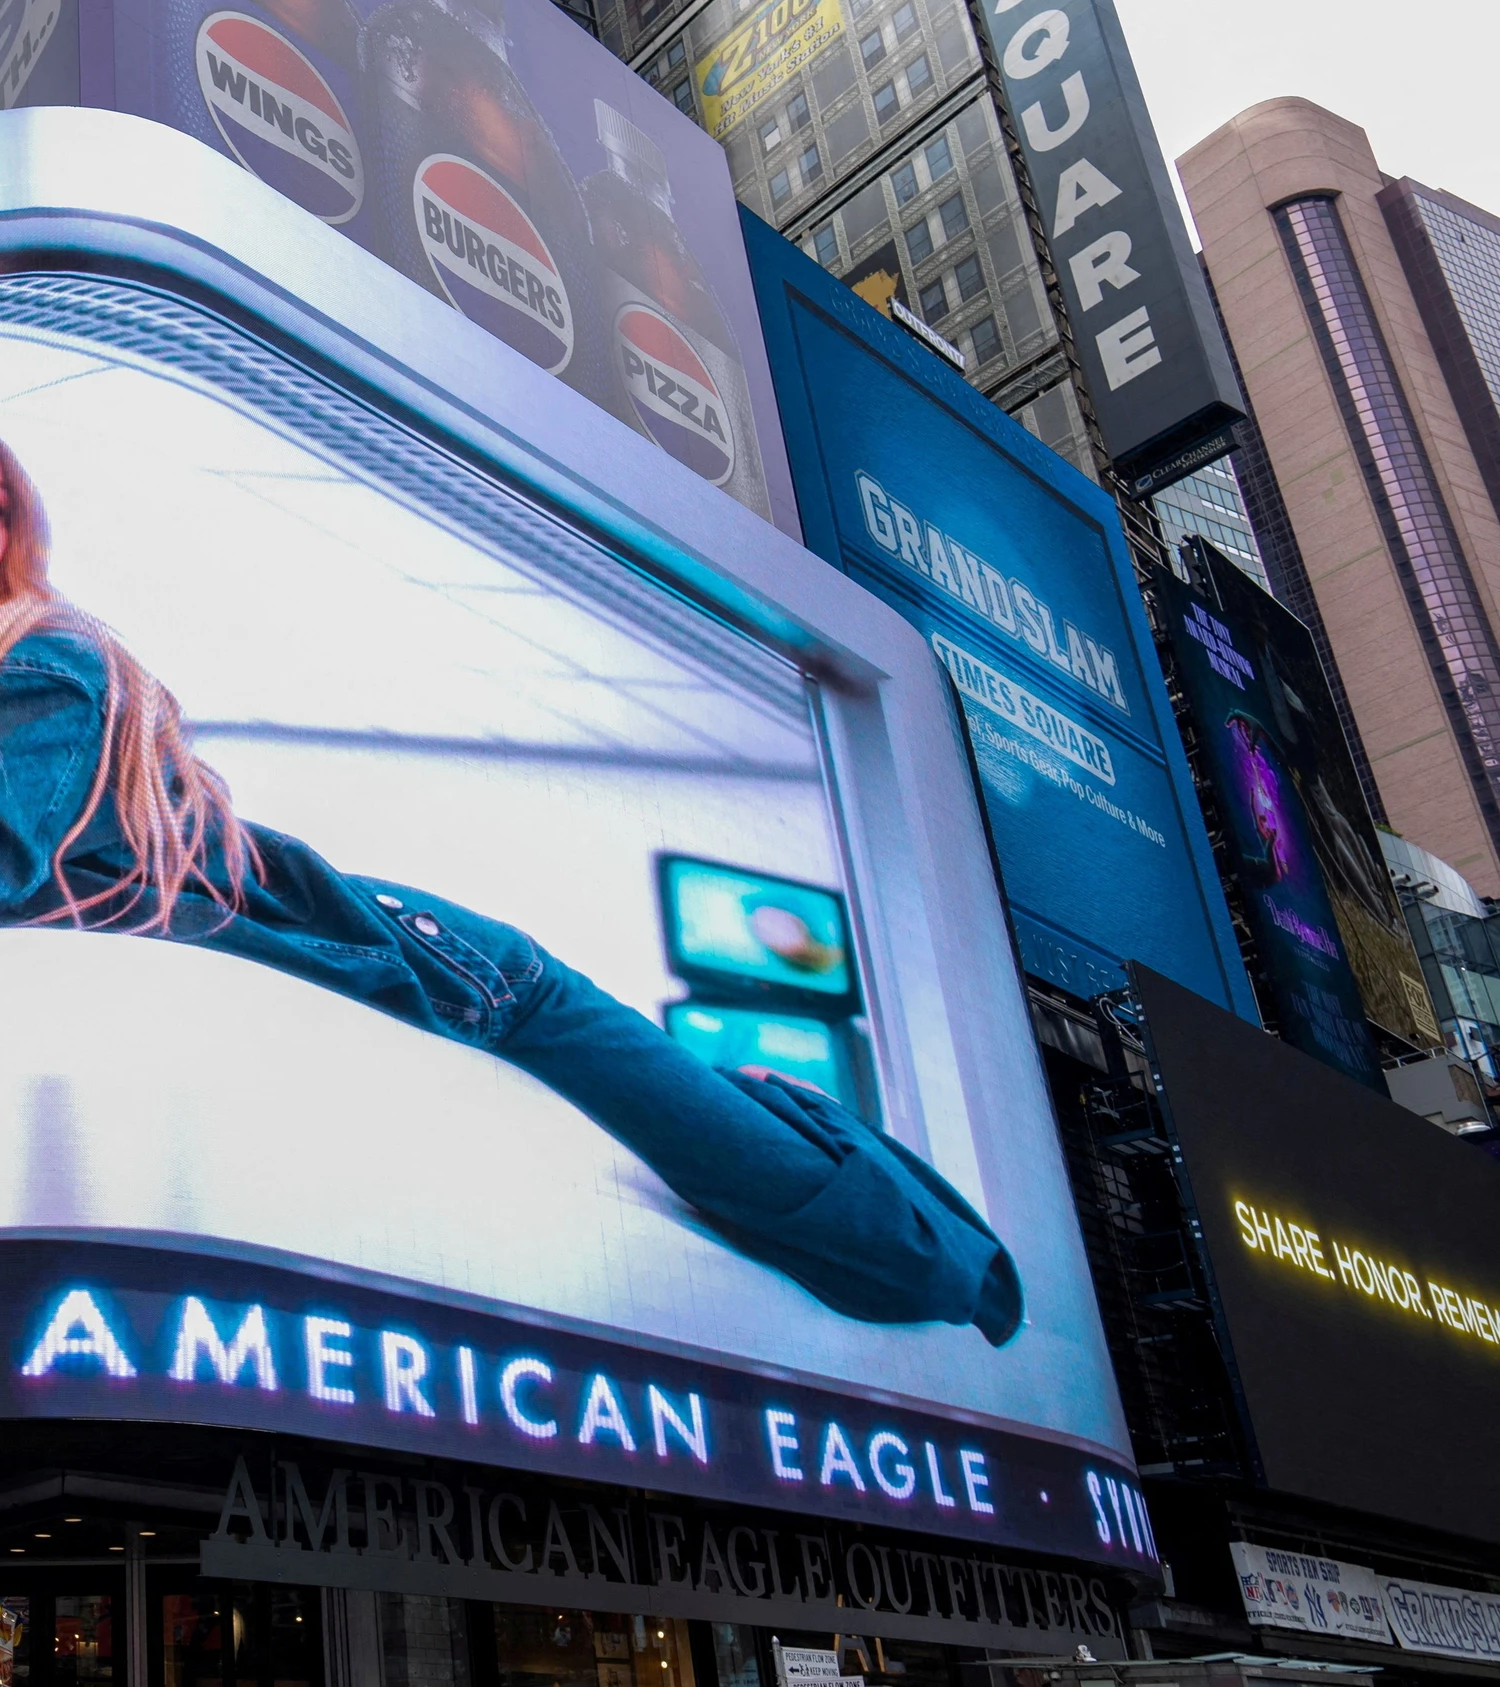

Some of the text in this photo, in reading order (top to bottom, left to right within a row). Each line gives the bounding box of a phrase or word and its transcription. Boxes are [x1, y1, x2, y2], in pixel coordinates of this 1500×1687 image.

[205, 49, 355, 180] WINGS
[714, 22, 841, 138] Hit Music Station
[721, 80, 755, 117] New
[803, 16, 824, 42] #1
[995, 0, 1162, 392] QUARE
[421, 195, 565, 330] BURGERS
[620, 343, 728, 445] PIZZA
[936, 640, 1111, 778] TIMES SQUARE
[985, 723, 1027, 763] Sports
[1061, 768, 1084, 801] Pop
[1085, 784, 1126, 821] Culture
[1126, 810, 1136, 829] &
[1136, 815, 1166, 848] More
[1234, 1200, 1336, 1281] SHARE.
[1332, 1241, 1433, 1319] HONOR.
[22, 1289, 994, 1514] AMERICAN EAGLE
[208, 1454, 1118, 1639] AMERICAN EAGLE OUTFITTERS
[1265, 1551, 1341, 1585] SPORTS FAN SHOP
[785, 1651, 837, 1664] PEDESTRIAN FLOW ZONE
[809, 1666, 839, 1676] KEEP MOVING
